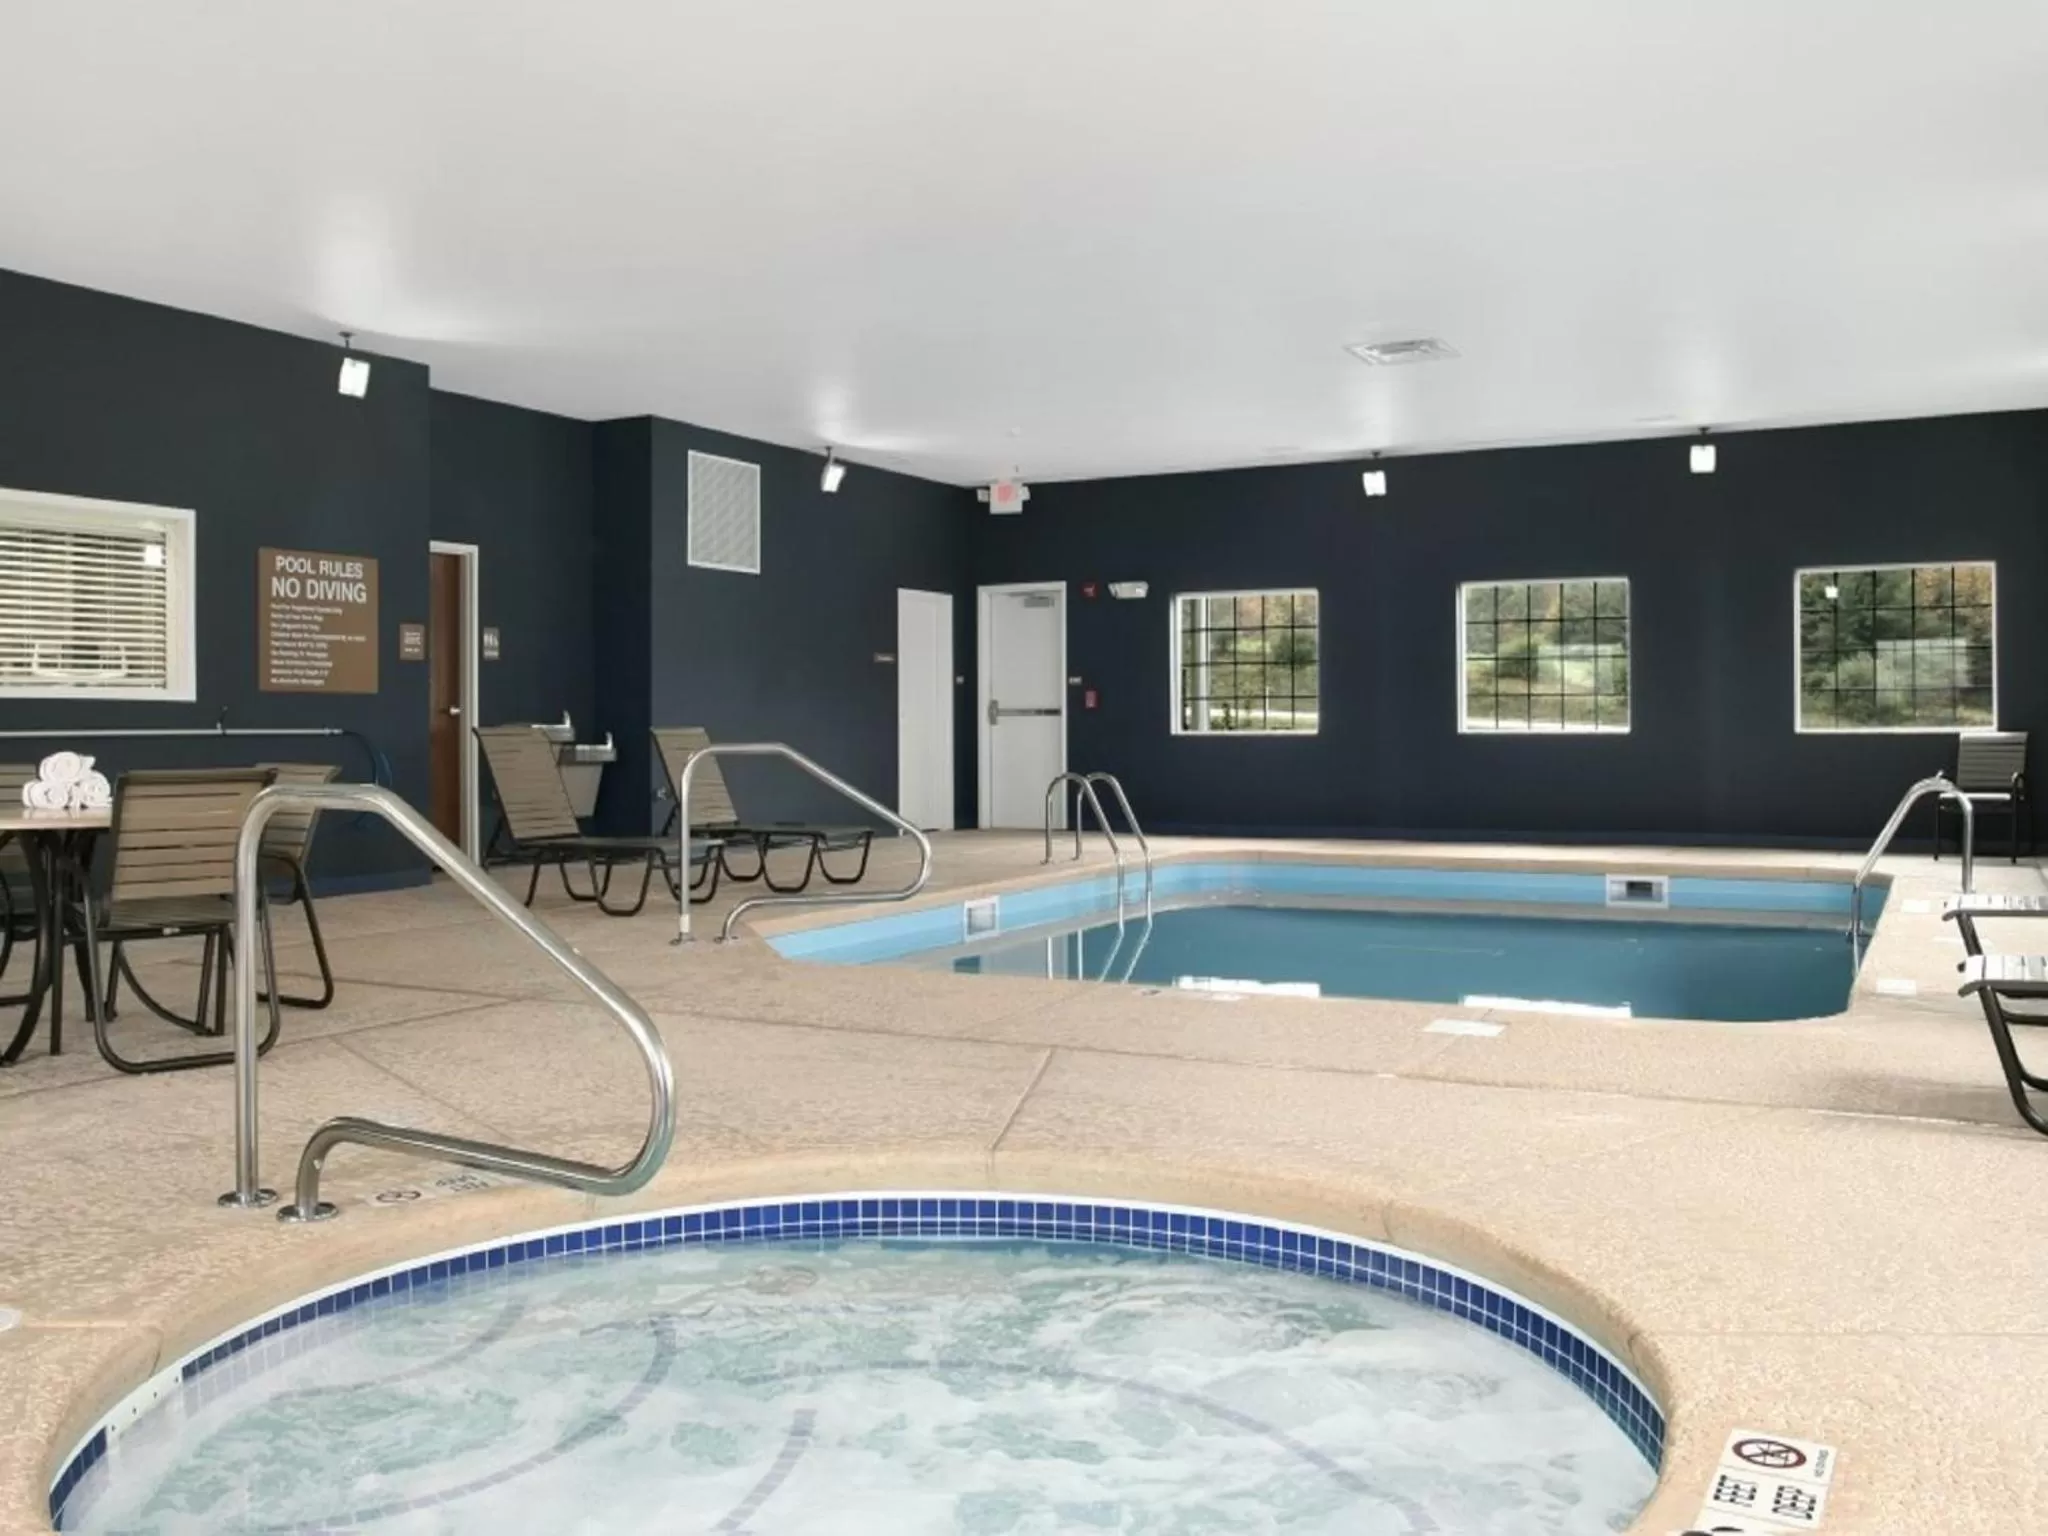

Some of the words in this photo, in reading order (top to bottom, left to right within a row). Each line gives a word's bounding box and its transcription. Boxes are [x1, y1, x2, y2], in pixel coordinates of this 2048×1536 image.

[275, 556, 316, 574] POOL
[319, 560, 363, 578] RULES
[271, 577, 300, 598] NO
[306, 579, 366, 603] DIVING
[1714, 1475, 1757, 1507] FEET
[1772, 1485, 1816, 1520] DEEP
